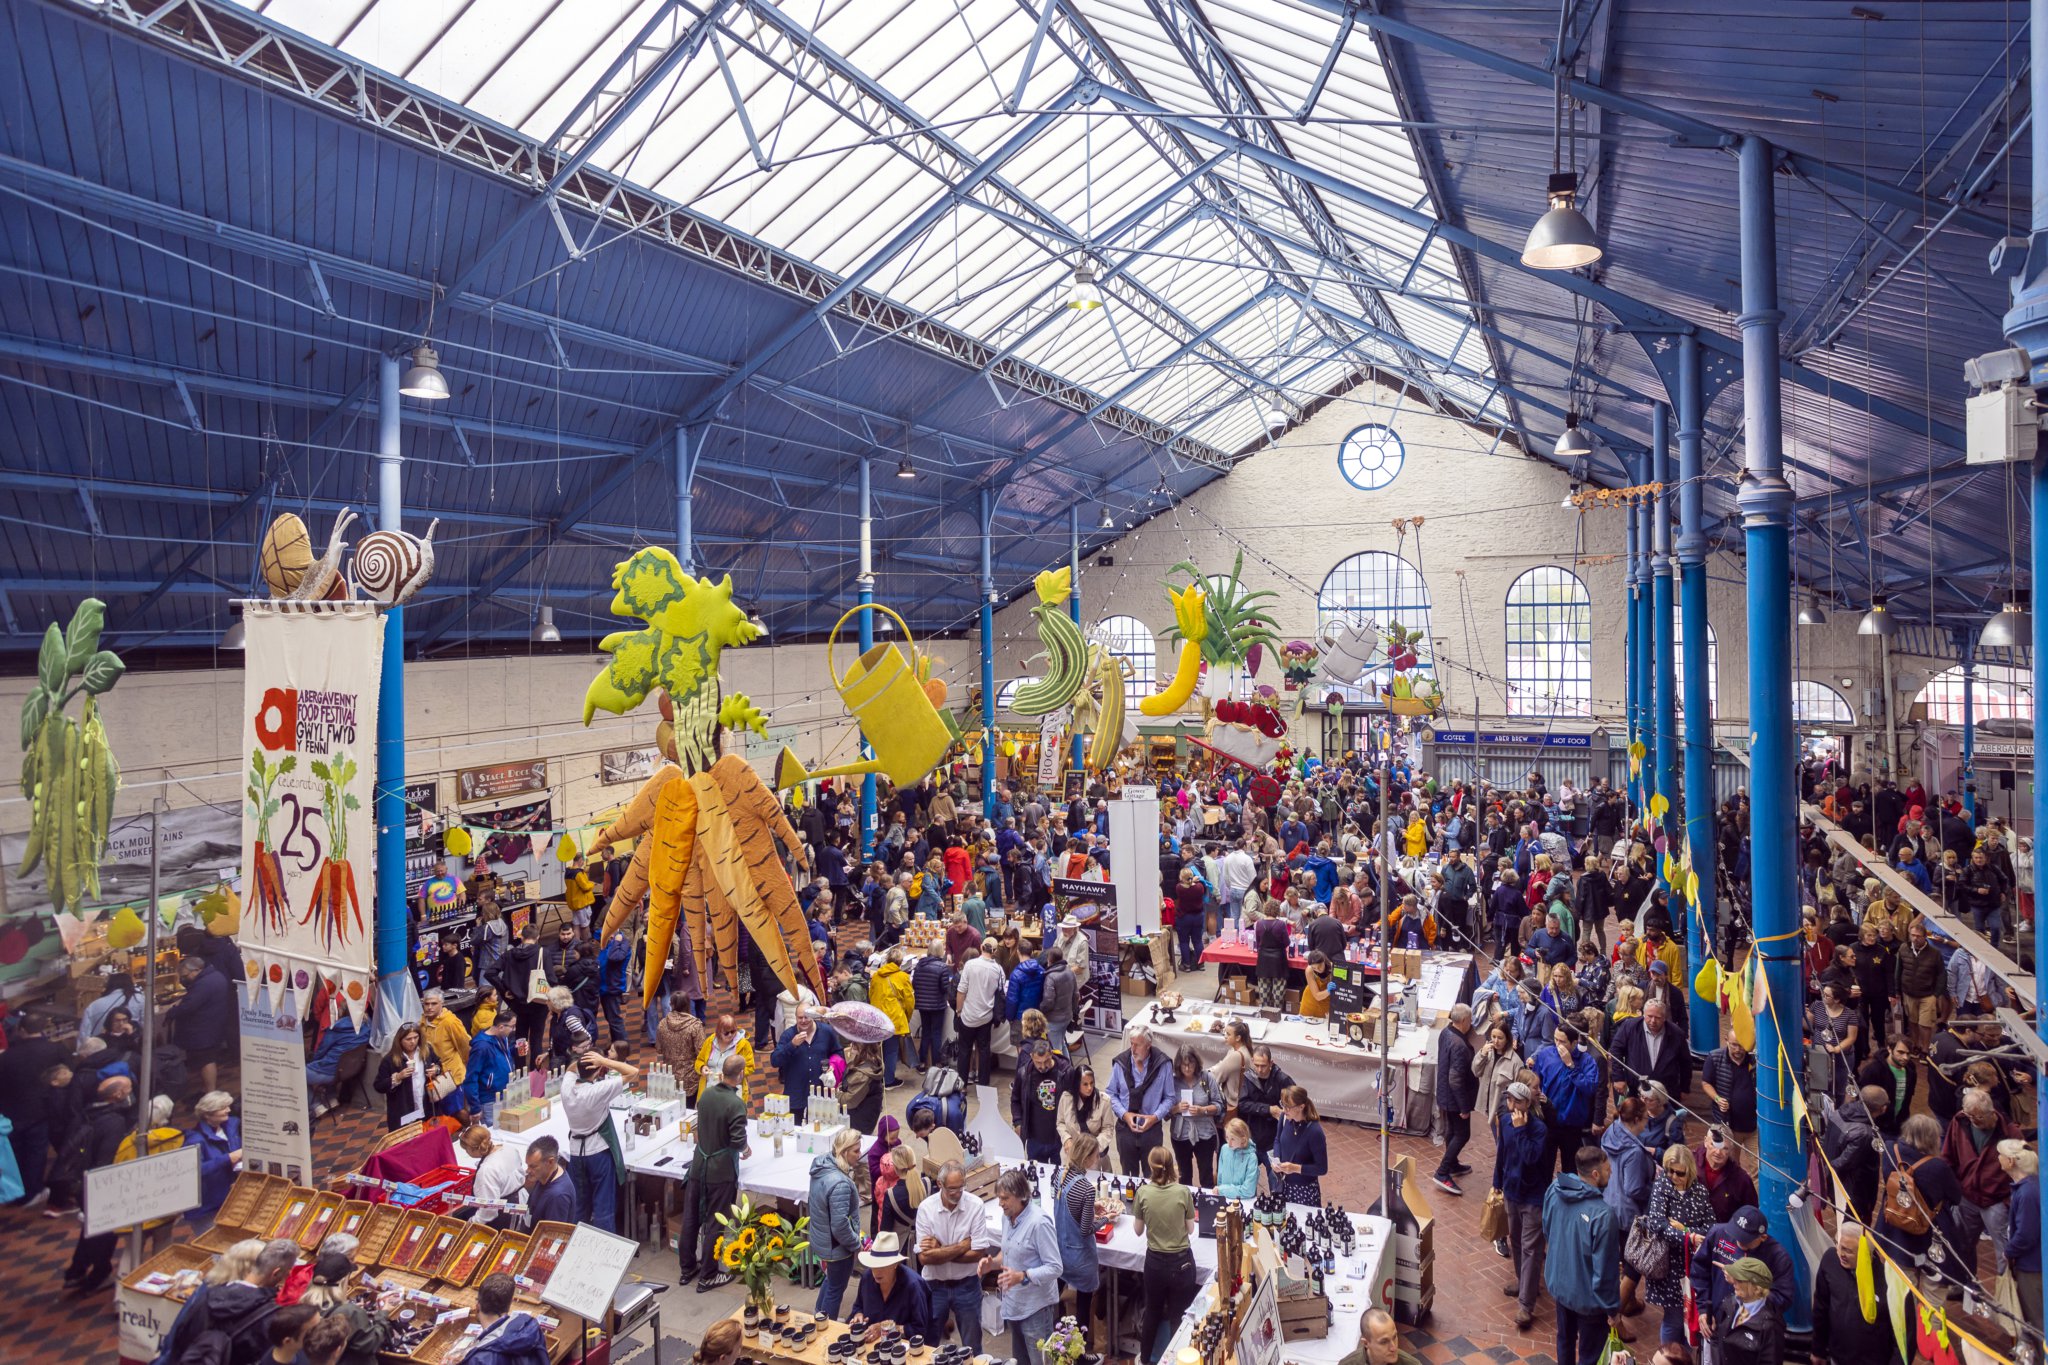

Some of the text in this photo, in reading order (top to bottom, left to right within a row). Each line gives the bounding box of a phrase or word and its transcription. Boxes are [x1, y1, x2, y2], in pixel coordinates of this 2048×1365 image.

[298, 690, 358, 708] ABERGAVENNY
[297, 704, 357, 726] FOOD FESTIVAL
[296, 721, 355, 745] GWYL FWYD
[297, 740, 329, 754] Y FENNI
[1981, 744, 2034, 754] ABERGAVENN
[280, 793, 323, 872] 25
[107, 840, 125, 851] ACK
[1061, 883, 1106, 894] MAYHAWK
